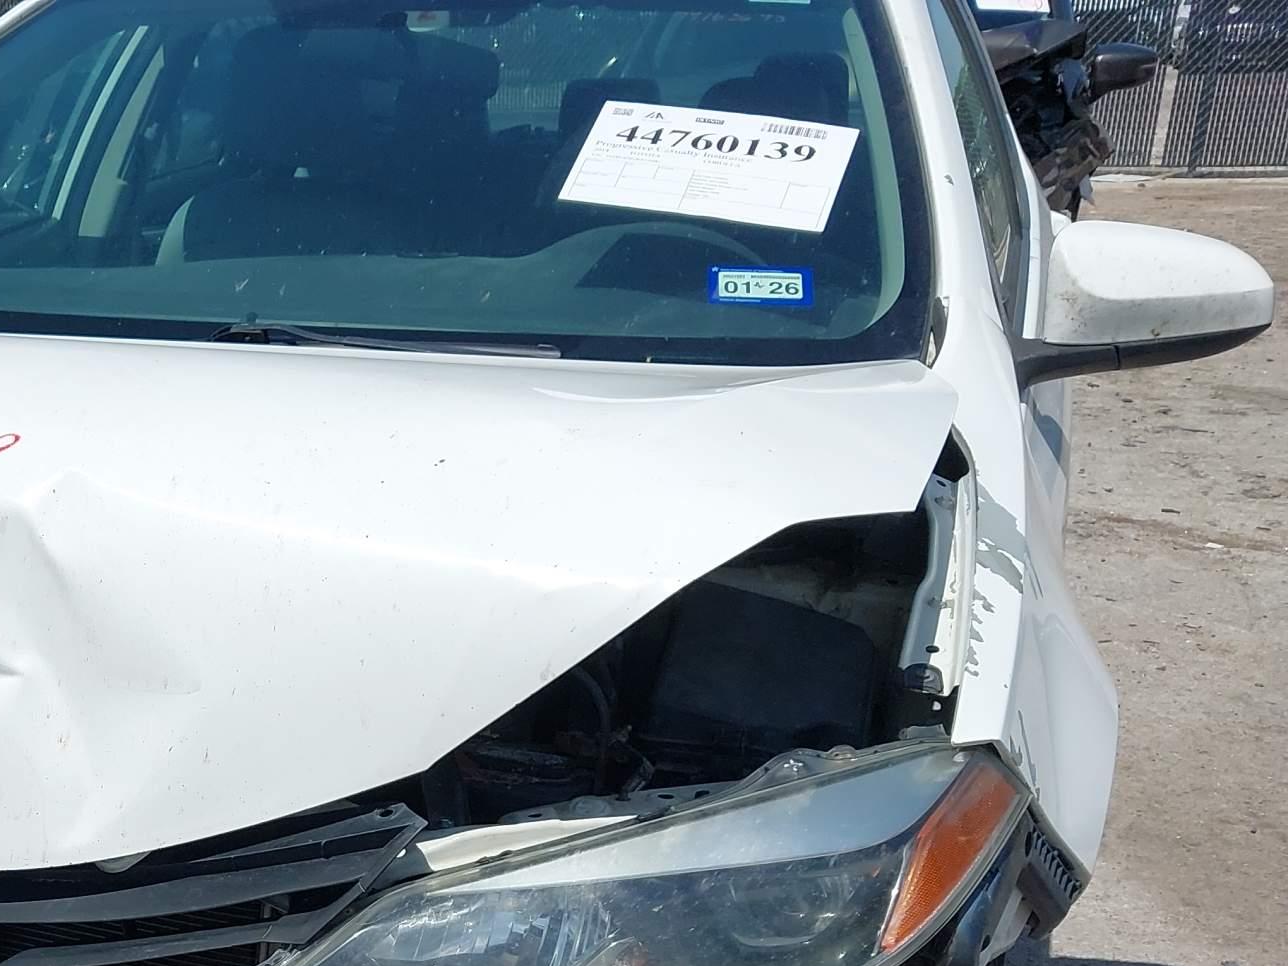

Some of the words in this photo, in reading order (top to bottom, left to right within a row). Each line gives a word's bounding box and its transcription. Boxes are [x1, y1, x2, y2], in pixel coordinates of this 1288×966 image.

[615, 125, 817, 163] 44760139
[724, 280, 752, 295] 01
[768, 281, 800, 296] 26
